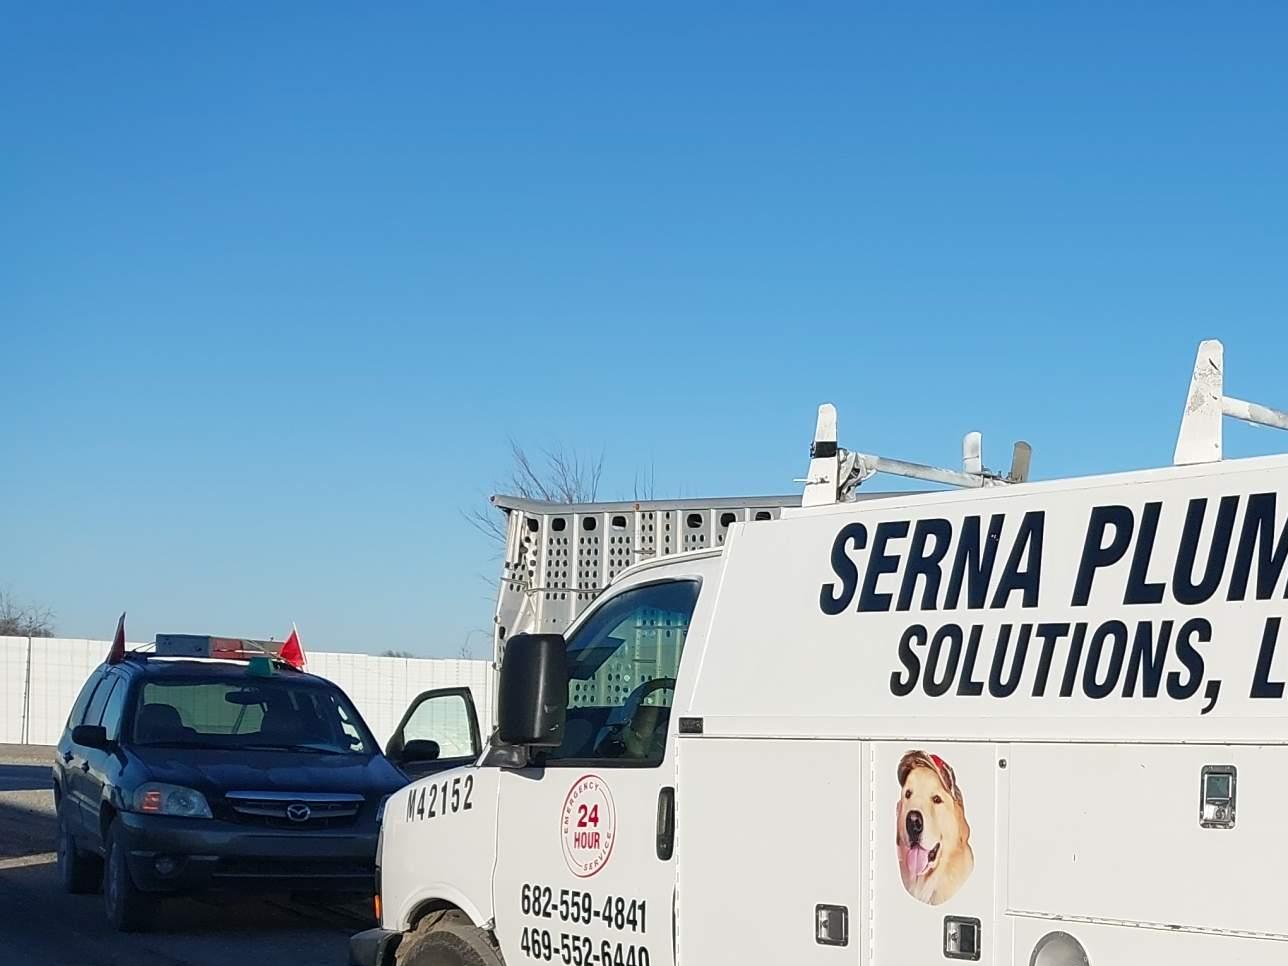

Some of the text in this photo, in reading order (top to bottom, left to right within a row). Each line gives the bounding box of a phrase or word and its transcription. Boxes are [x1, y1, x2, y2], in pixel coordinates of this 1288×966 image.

[819, 509, 1046, 616] SERNA
[889, 616, 1223, 716] SOLUTIONS,
[406, 774, 474, 823] M42152
[563, 781, 600, 834] EMERGENCY
[576, 803, 599, 828] 24
[573, 831, 601, 850] HOUR
[583, 831, 612, 871] SERVICE
[521, 883, 647, 934] 682-559-4841
